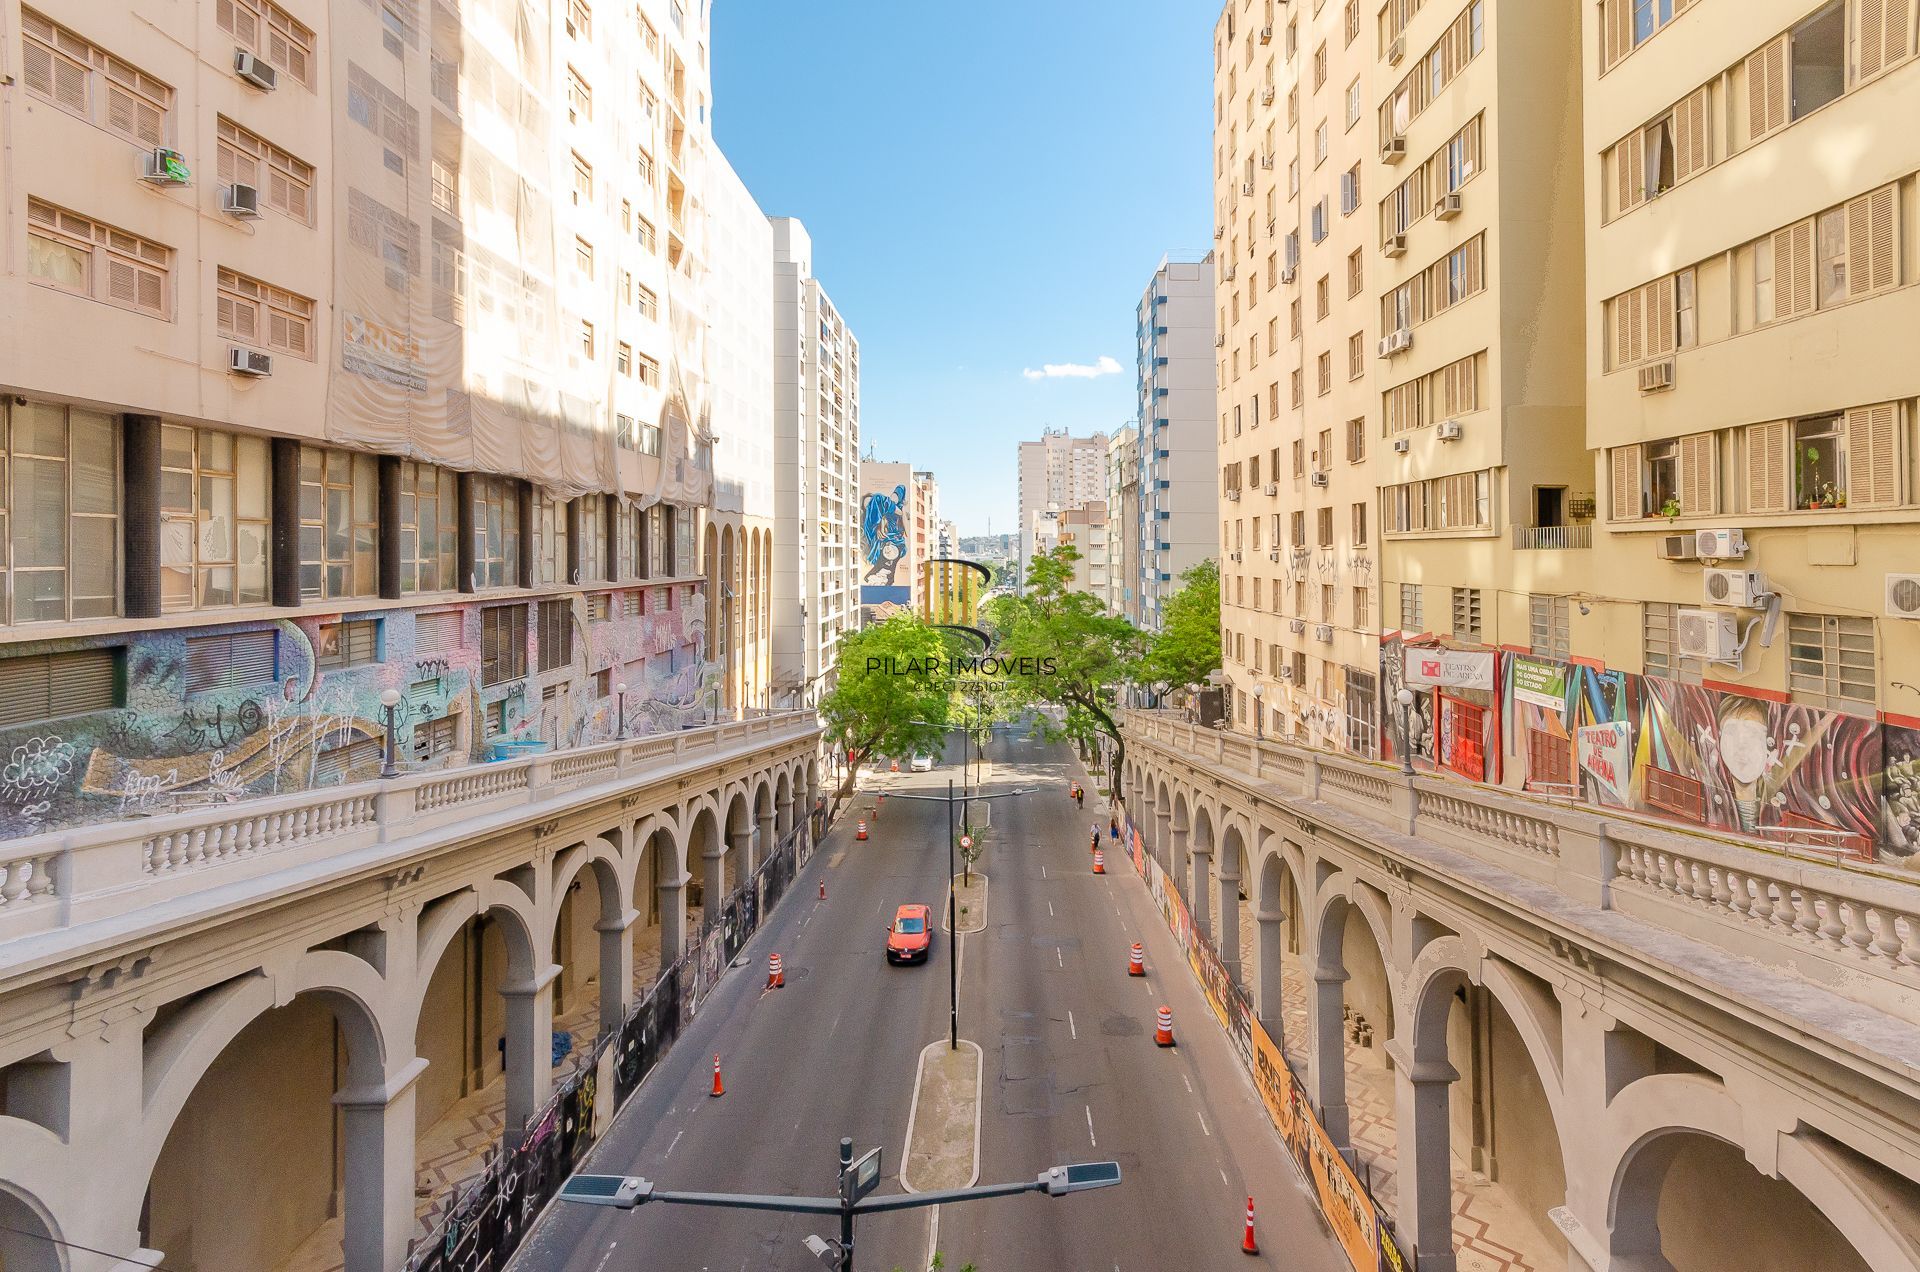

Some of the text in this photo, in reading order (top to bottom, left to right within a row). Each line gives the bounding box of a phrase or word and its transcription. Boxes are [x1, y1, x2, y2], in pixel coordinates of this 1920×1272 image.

[1443, 662, 1477, 672] TEATRO
[1457, 672, 1484, 681] ARENA
[1585, 728, 1617, 750] TEATRO
[1593, 745, 1603, 758] DE
